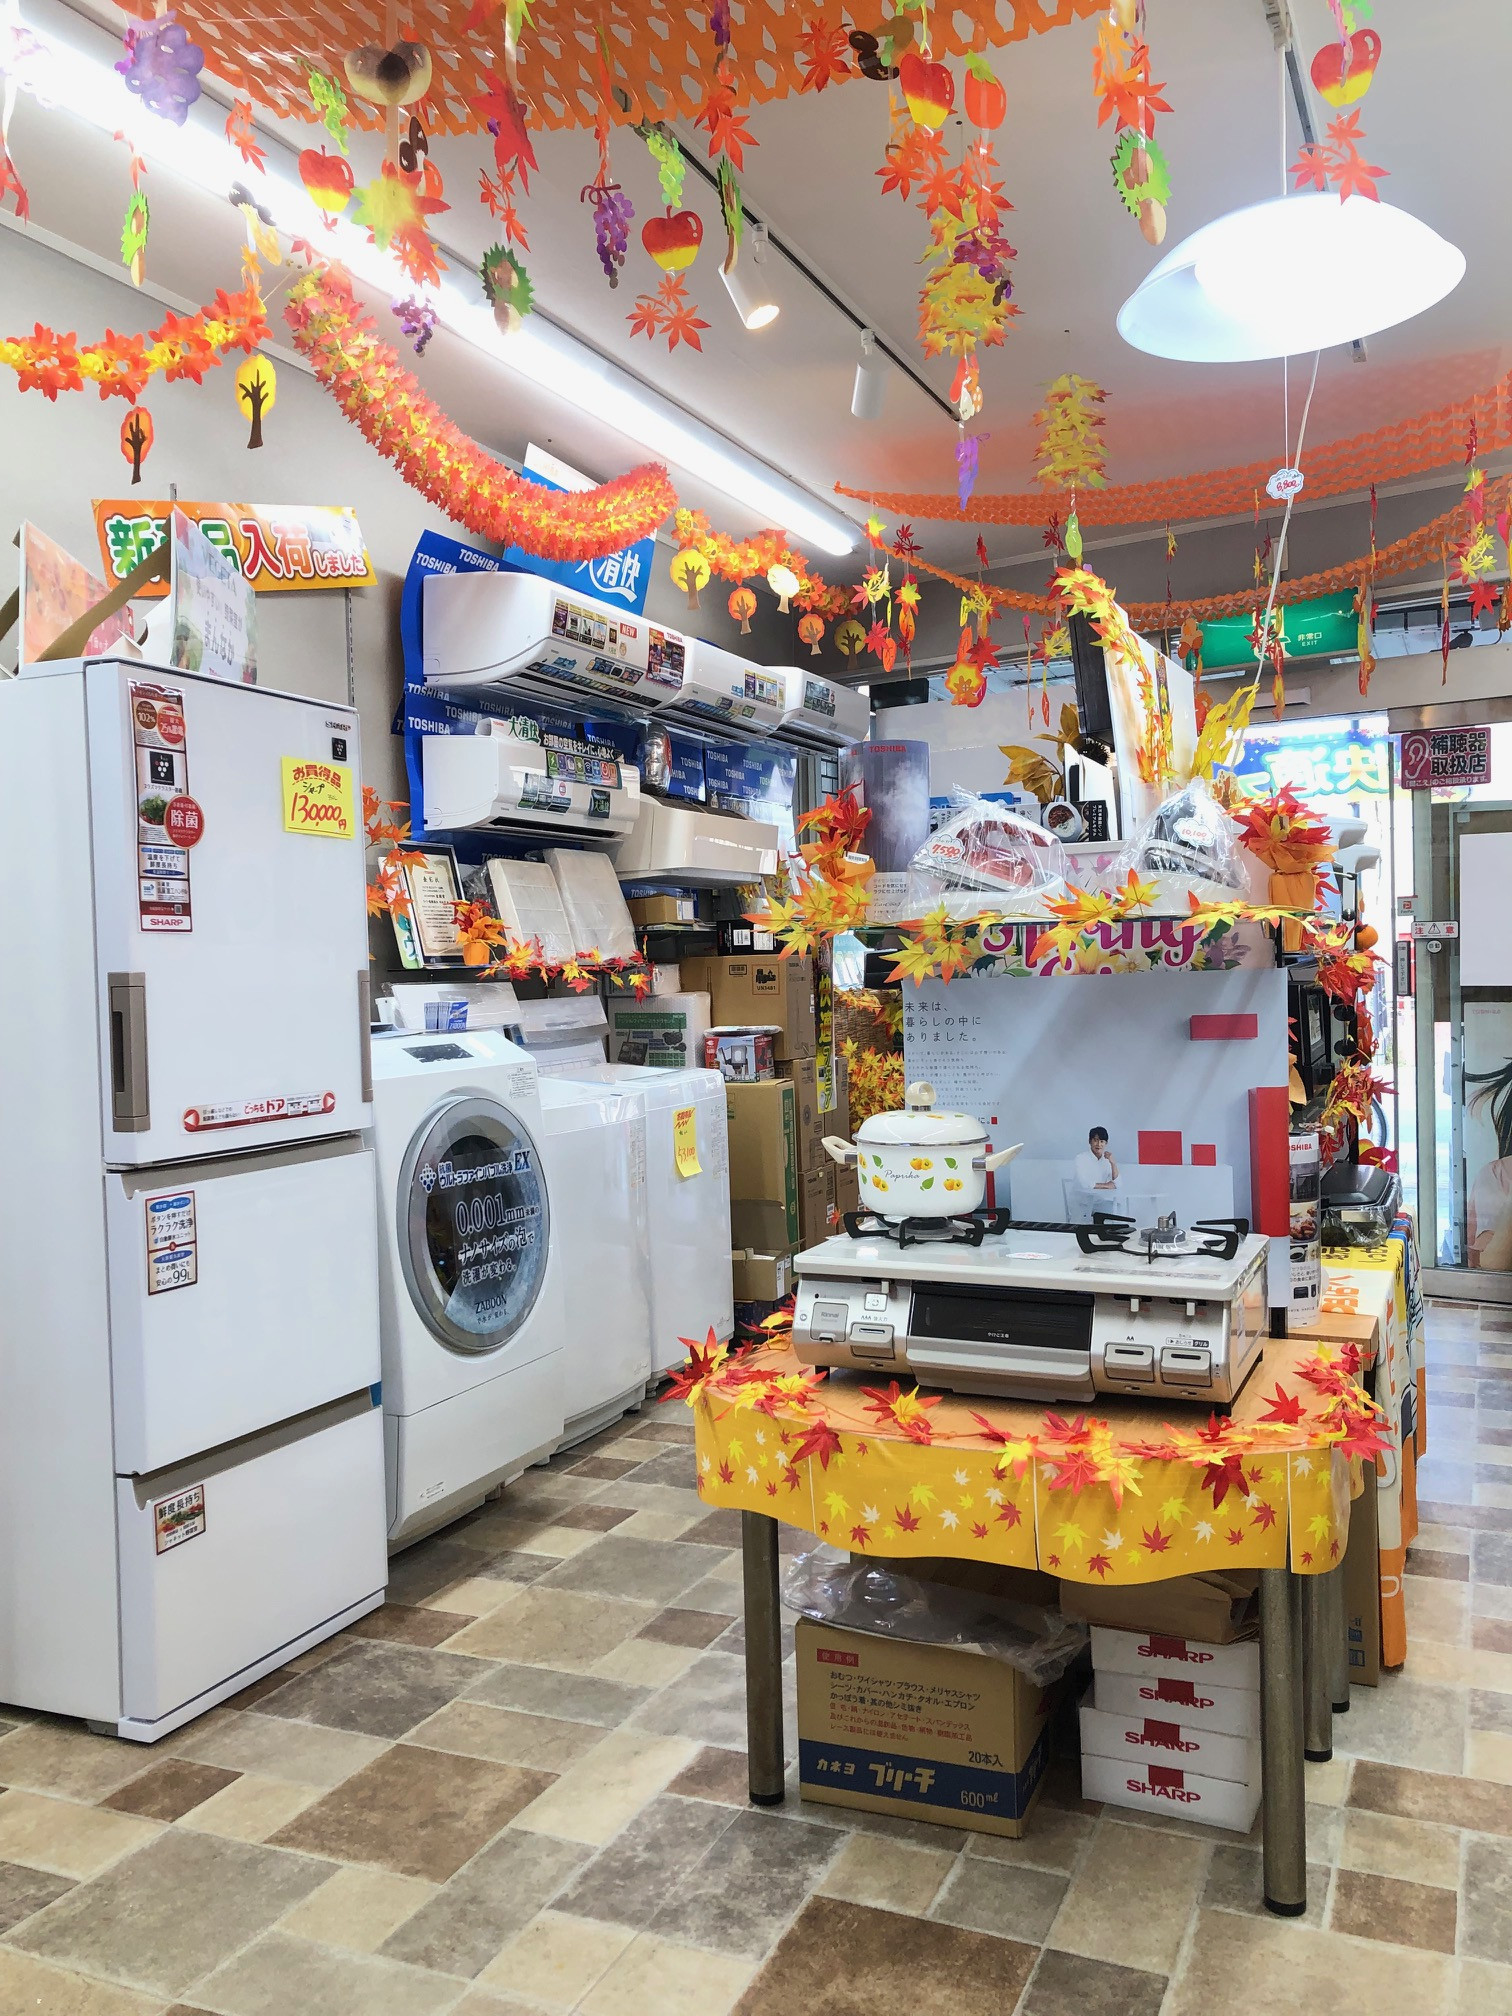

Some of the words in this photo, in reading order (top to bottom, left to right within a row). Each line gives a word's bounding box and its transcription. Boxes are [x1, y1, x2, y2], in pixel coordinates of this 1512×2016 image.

[416, 552, 458, 575] TOSHIBA
[459, 549, 500, 573] TOSHIBA
[621, 624, 635, 636] NEW
[1298, 632, 1322, 641] 非常口
[408, 683, 450, 701] TOSHIBA
[445, 705, 483, 722] TOSHIBA
[479, 700, 515, 716] TOSHIBA
[138, 712, 156, 723] 102%
[408, 716, 451, 735] TOSHIBA
[508, 717, 541, 743] 大清快
[587, 734, 616, 748] TOSHIBA
[1430, 731, 1488, 755] 補聴器
[680, 757, 702, 770] TOSHIBA
[706, 750, 729, 764] TOSHIBA
[743, 759, 763, 772] TOSHIBA
[1430, 753, 1488, 776] 取扱店
[292, 764, 342, 788] お買得品
[671, 769, 686, 780] HIBA
[725, 768, 745, 781] TOSHIBA
[708, 778, 729, 790] TOSHIBA
[170, 809, 199, 829] 除菌
[149, 917, 184, 927] SHARP
[1414, 926, 1424, 935] 注
[983, 920, 1204, 968] Sing
[904, 1001, 949, 1013] 未来は、
[905, 1015, 982, 1028] 暮らしの中に
[906, 1031, 977, 1042] ありました。
[1290, 1143, 1313, 1152] SHIBA
[514, 1150, 531, 1171] EX
[884, 1169, 921, 1182] Paprika
[150, 1217, 194, 1236] ラクラク洗浄
[459, 1226, 535, 1266] ナノサイズの泡で
[461, 1257, 517, 1287] 洗濯が変わる。
[474, 1294, 507, 1314] ZABOON
[158, 1492, 200, 1520] 鮮度長持ち
[1137, 1644, 1215, 1664] SHARP
[1139, 1687, 1215, 1709] SHARP
[1124, 1731, 1200, 1753] SHARP
[968, 1750, 1004, 1768] 20本入
[816, 1758, 856, 1775] カネヨ
[868, 1760, 936, 1794] ブリーチ
[1126, 1779, 1201, 1803] SHARP
